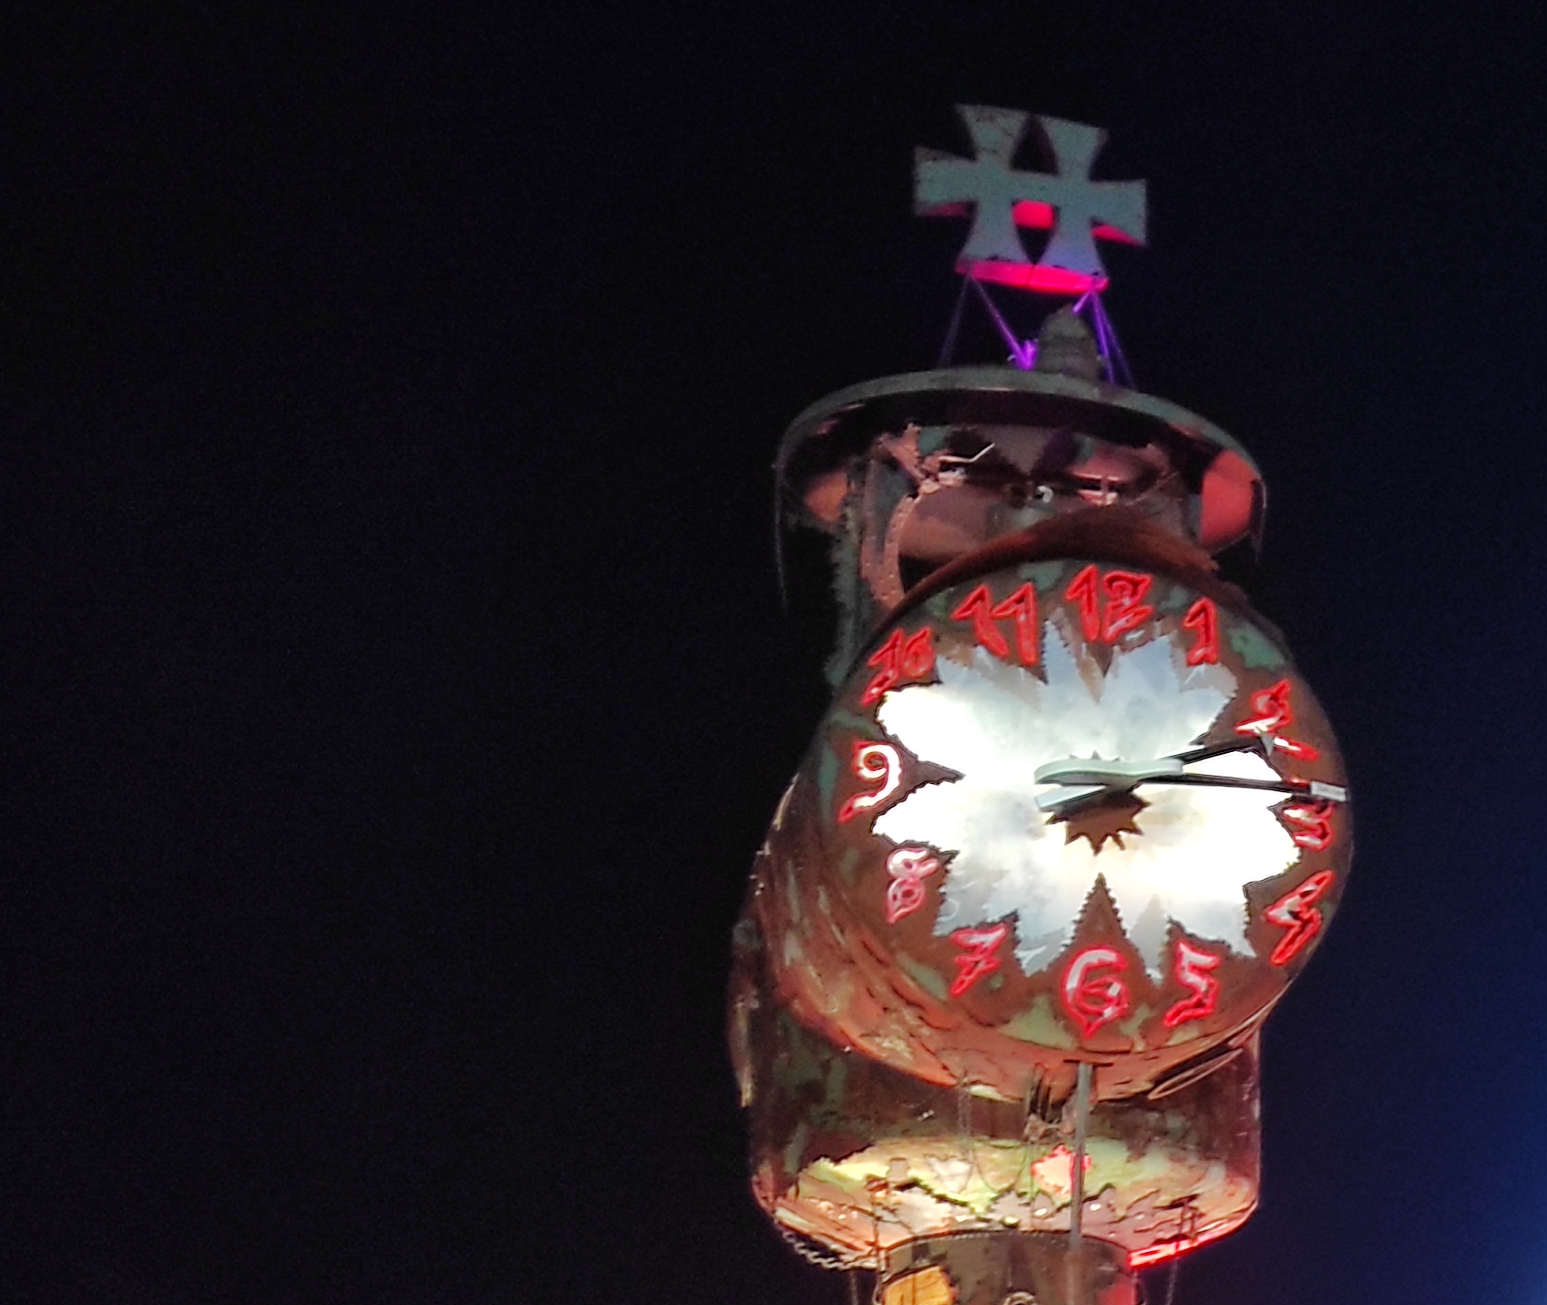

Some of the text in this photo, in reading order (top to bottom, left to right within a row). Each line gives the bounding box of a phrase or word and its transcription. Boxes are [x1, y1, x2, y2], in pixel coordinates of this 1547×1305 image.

[951, 582, 1038, 667] 11
[1066, 564, 1155, 643] 12
[1182, 596, 1217, 666] 1
[862, 625, 933, 705] 10
[1234, 678, 1321, 763] 2
[838, 740, 901, 823] 9
[1280, 776, 1335, 853] 3
[886, 846, 940, 924] 8
[1263, 869, 1334, 966] 4
[950, 923, 1009, 998] 7
[1061, 945, 1129, 1038] 6
[1164, 940, 1221, 1029] 5
